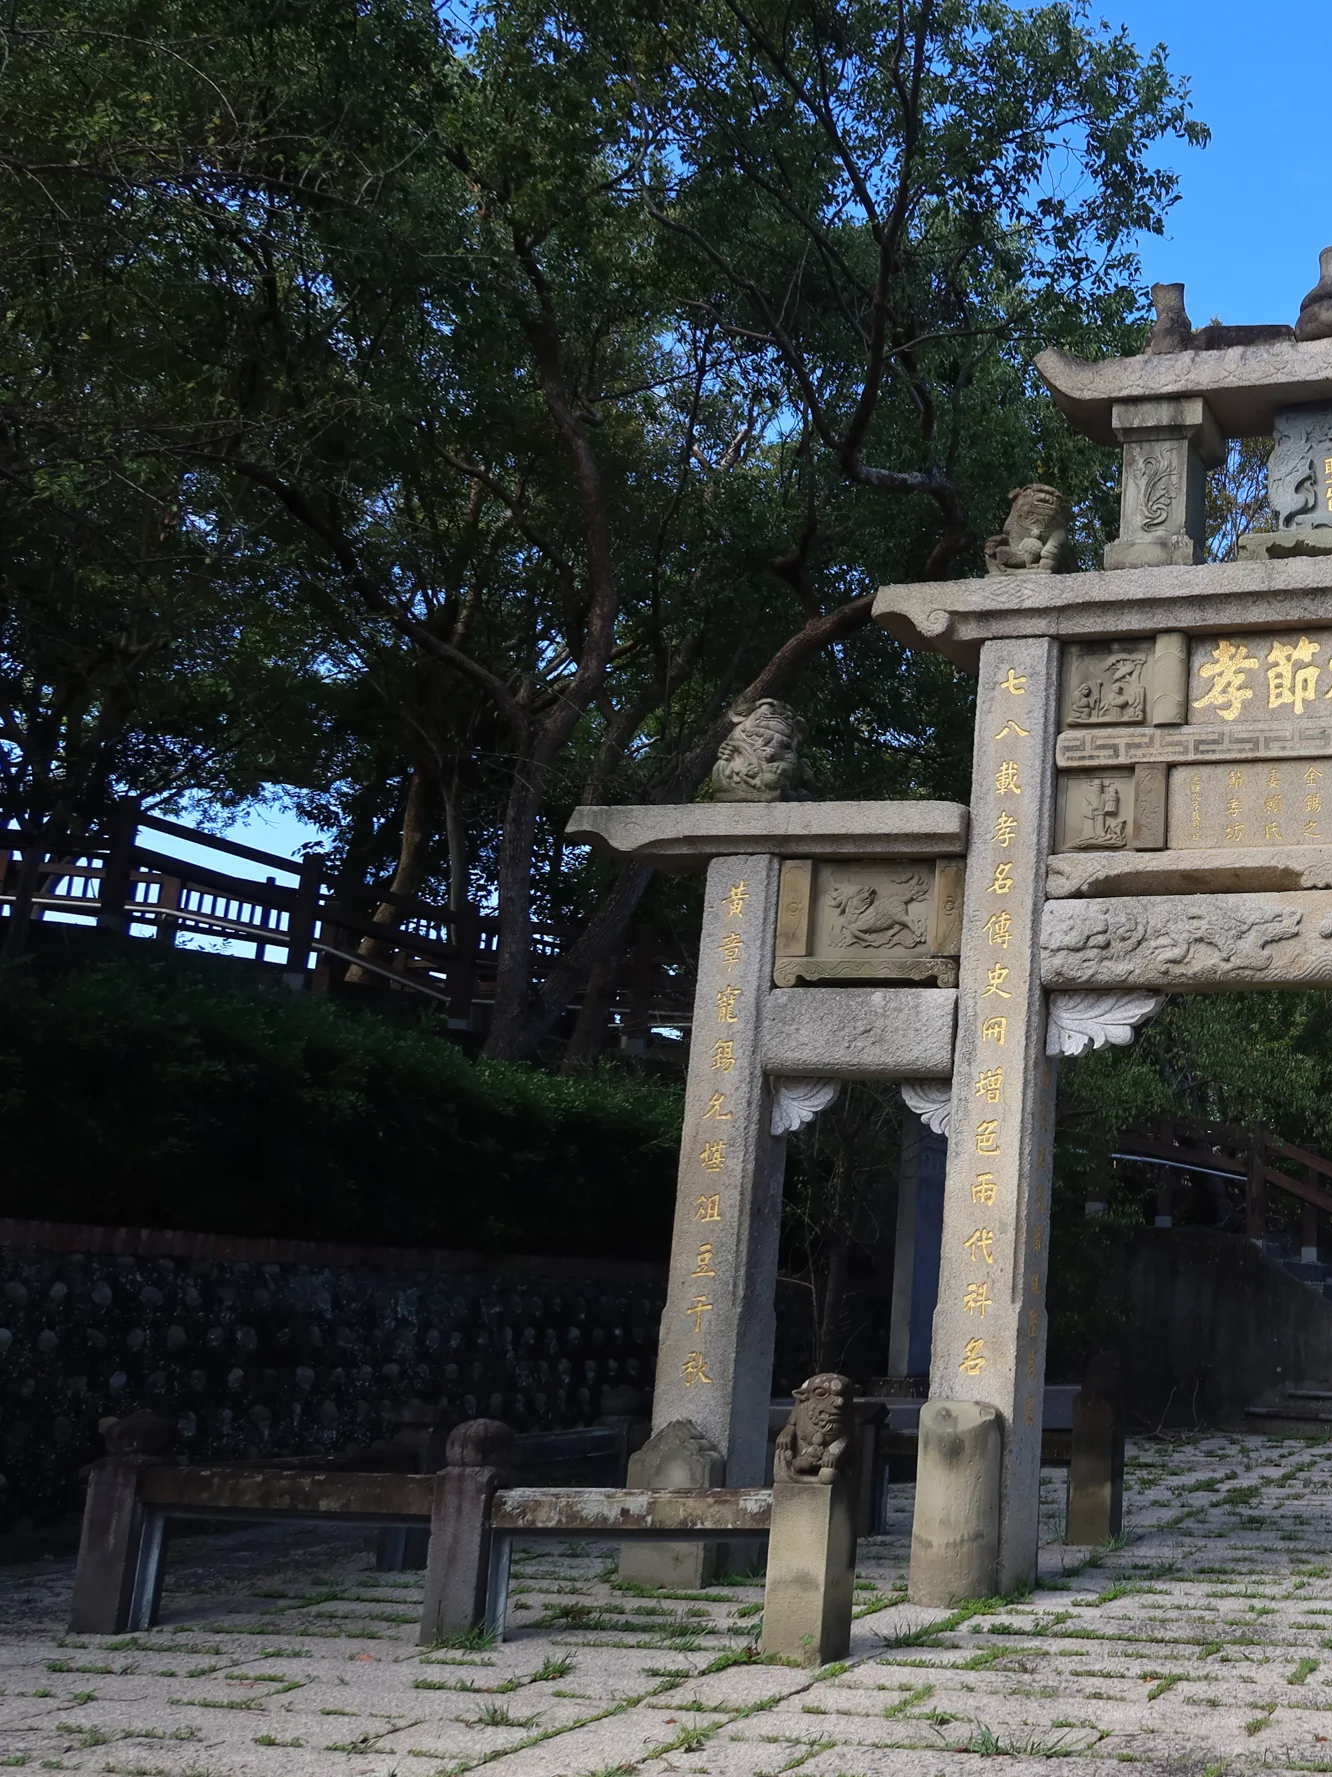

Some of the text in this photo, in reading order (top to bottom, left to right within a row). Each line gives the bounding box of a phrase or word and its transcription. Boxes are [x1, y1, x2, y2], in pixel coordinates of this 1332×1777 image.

[1225, 770, 1244, 842] 節孝坊
[1262, 767, 1284, 840] 妻賴氏
[1303, 766, 1323, 838] 金錫之
